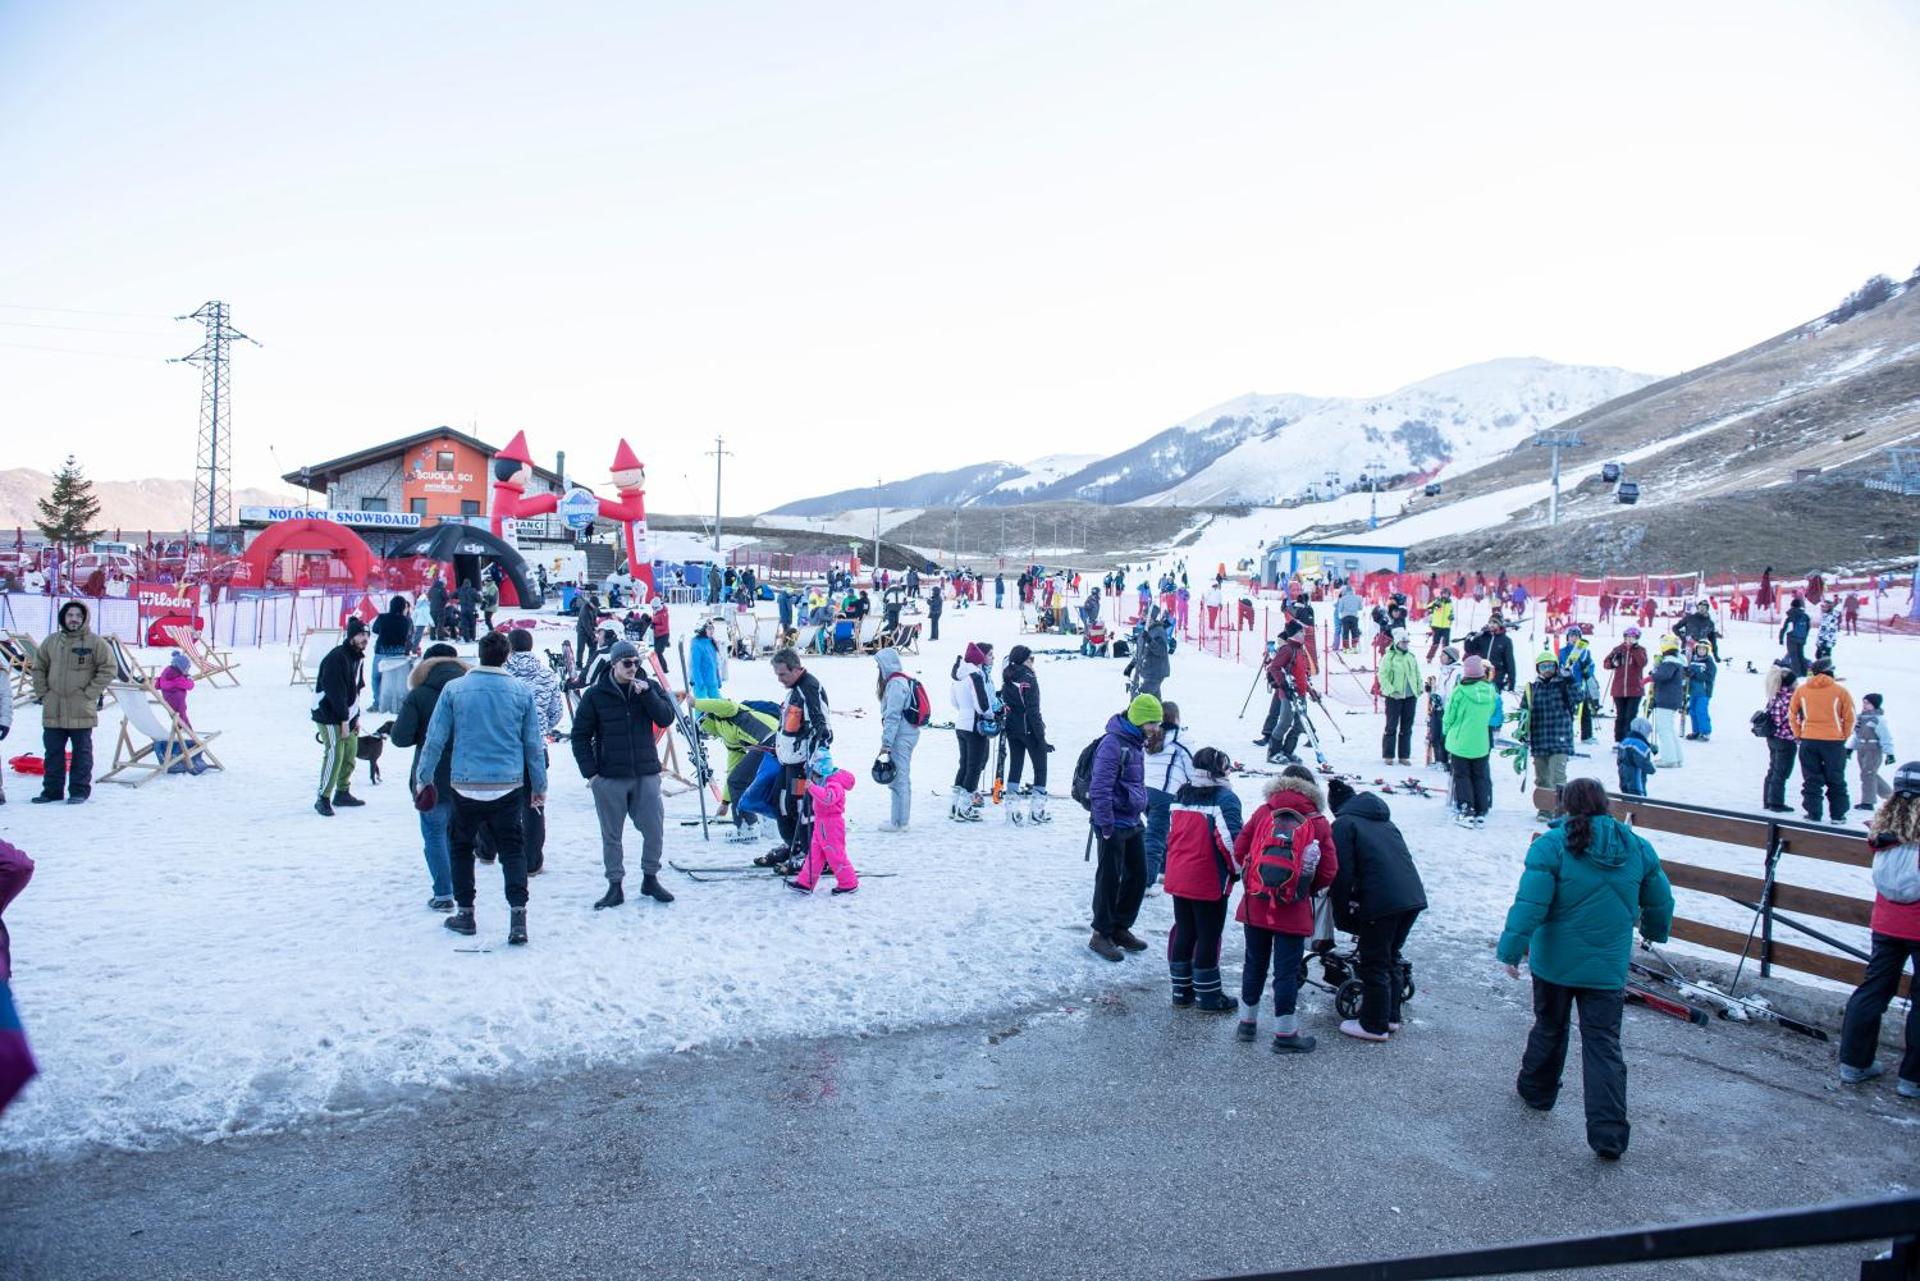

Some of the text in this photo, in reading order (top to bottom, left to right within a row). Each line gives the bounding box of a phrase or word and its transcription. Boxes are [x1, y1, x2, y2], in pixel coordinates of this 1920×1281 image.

[458, 473, 473, 482] SCI
[268, 509, 304, 520] NOLO
[306, 511, 328, 520] SCI
[336, 512, 419, 525] SNOWBOARD
[139, 592, 192, 608] Wilson
